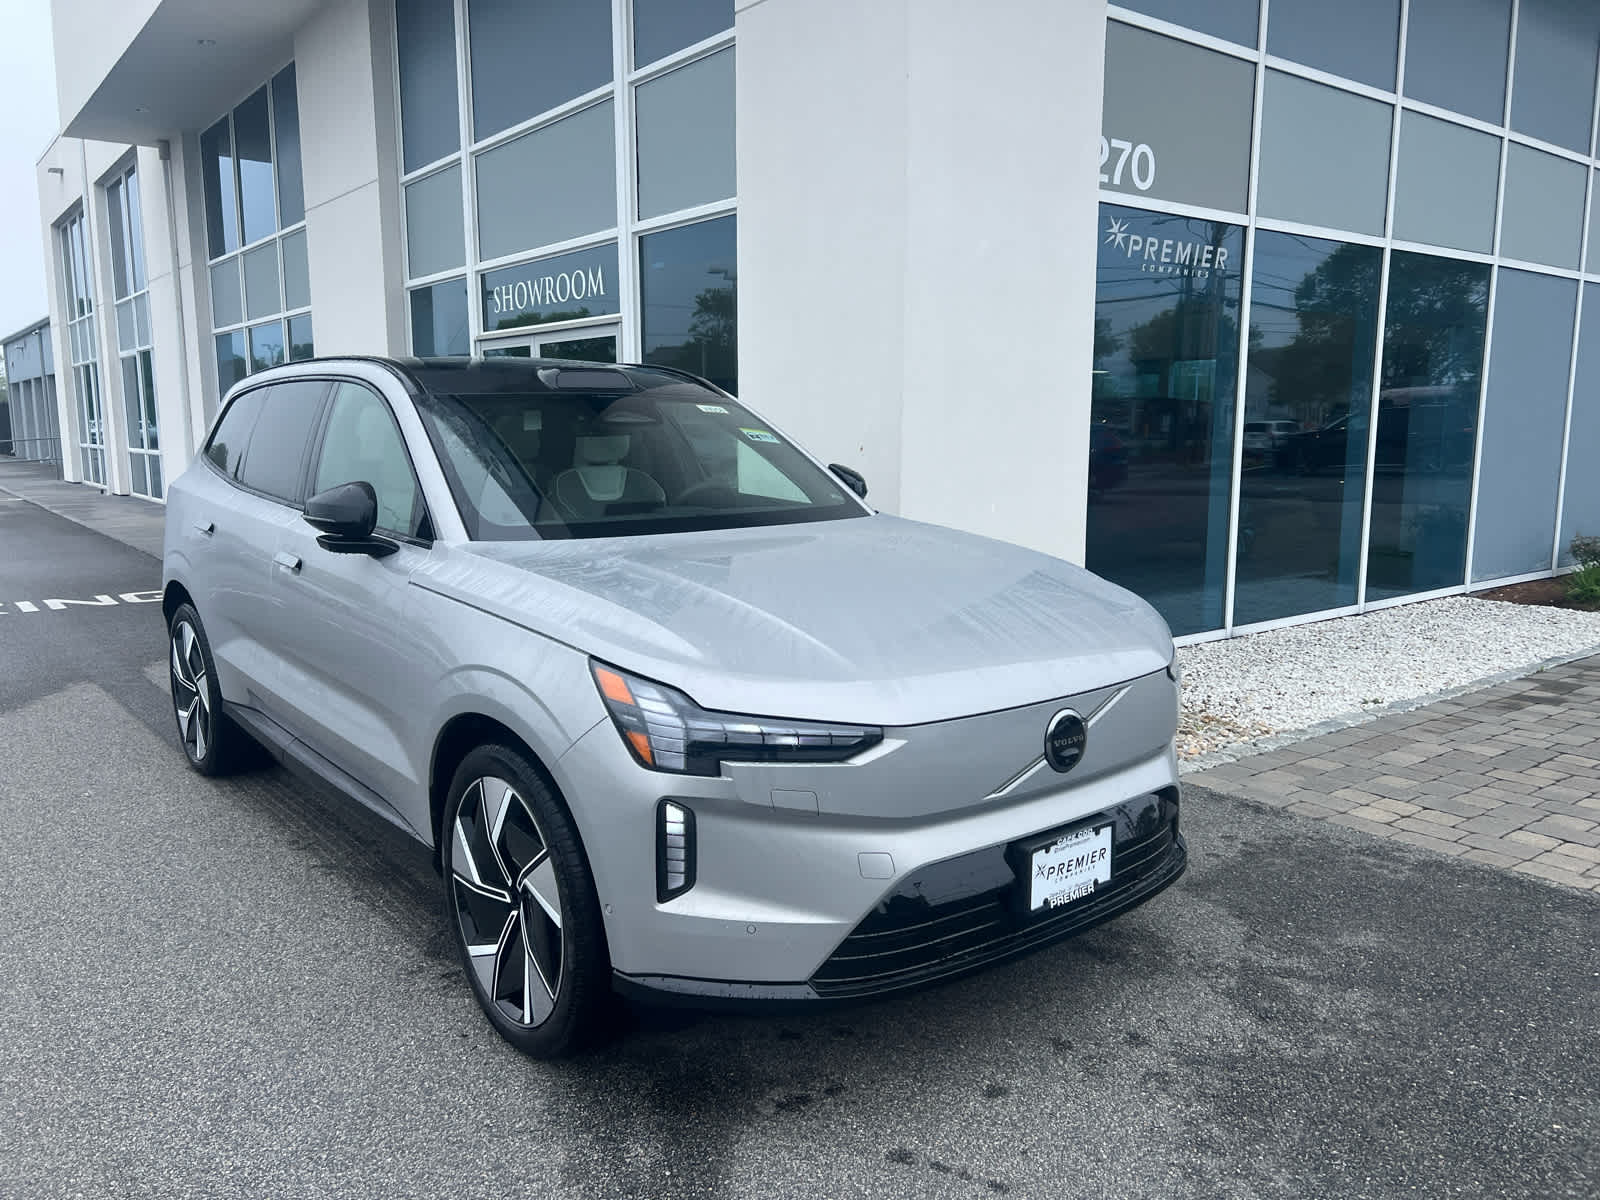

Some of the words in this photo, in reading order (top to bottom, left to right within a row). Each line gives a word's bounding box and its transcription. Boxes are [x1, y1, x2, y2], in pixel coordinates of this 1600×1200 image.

[1099, 135, 1156, 191] 270
[1127, 234, 1229, 270] PREMIER
[1141, 263, 1210, 279] COMPANIES
[493, 264, 605, 313] SHOWROOM
[1046, 847, 1107, 880] PREMIER
[1050, 884, 1095, 909] PREMIER
